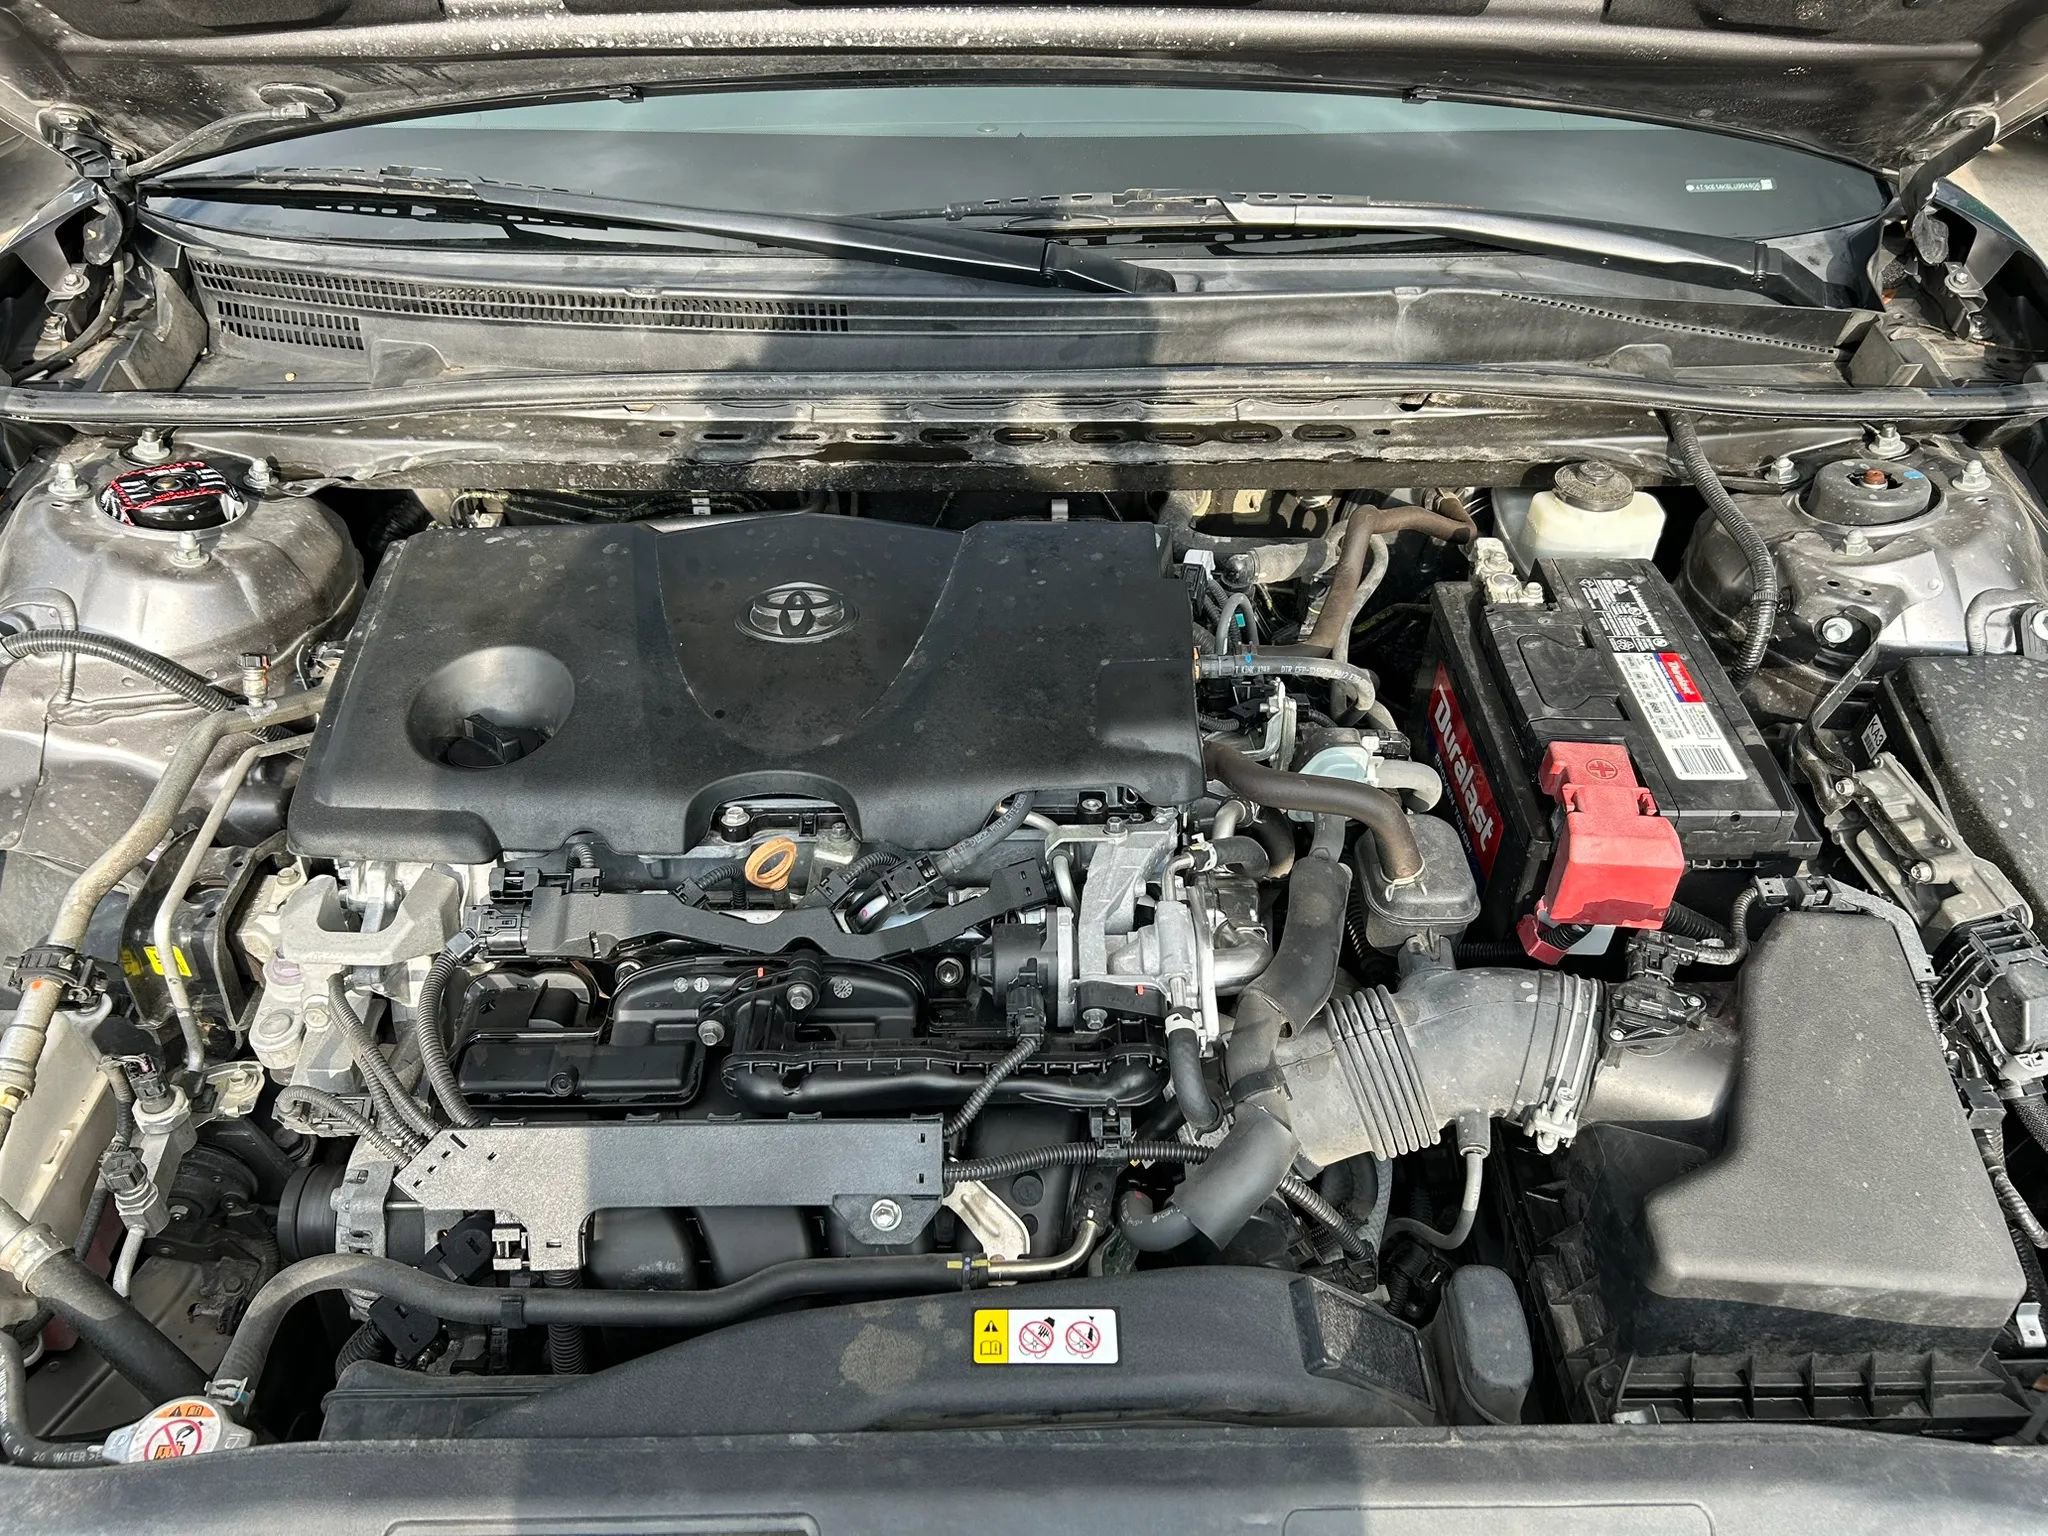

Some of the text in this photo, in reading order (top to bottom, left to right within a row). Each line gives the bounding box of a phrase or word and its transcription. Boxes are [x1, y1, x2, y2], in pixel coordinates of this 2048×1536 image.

[1667, 661, 1696, 695] Duralast
[1869, 718, 1884, 746] KA3
[1434, 683, 1493, 852] Duralast
[1434, 753, 1473, 853] PROVEN TOUGH
[53, 1451, 86, 1462] WATER
